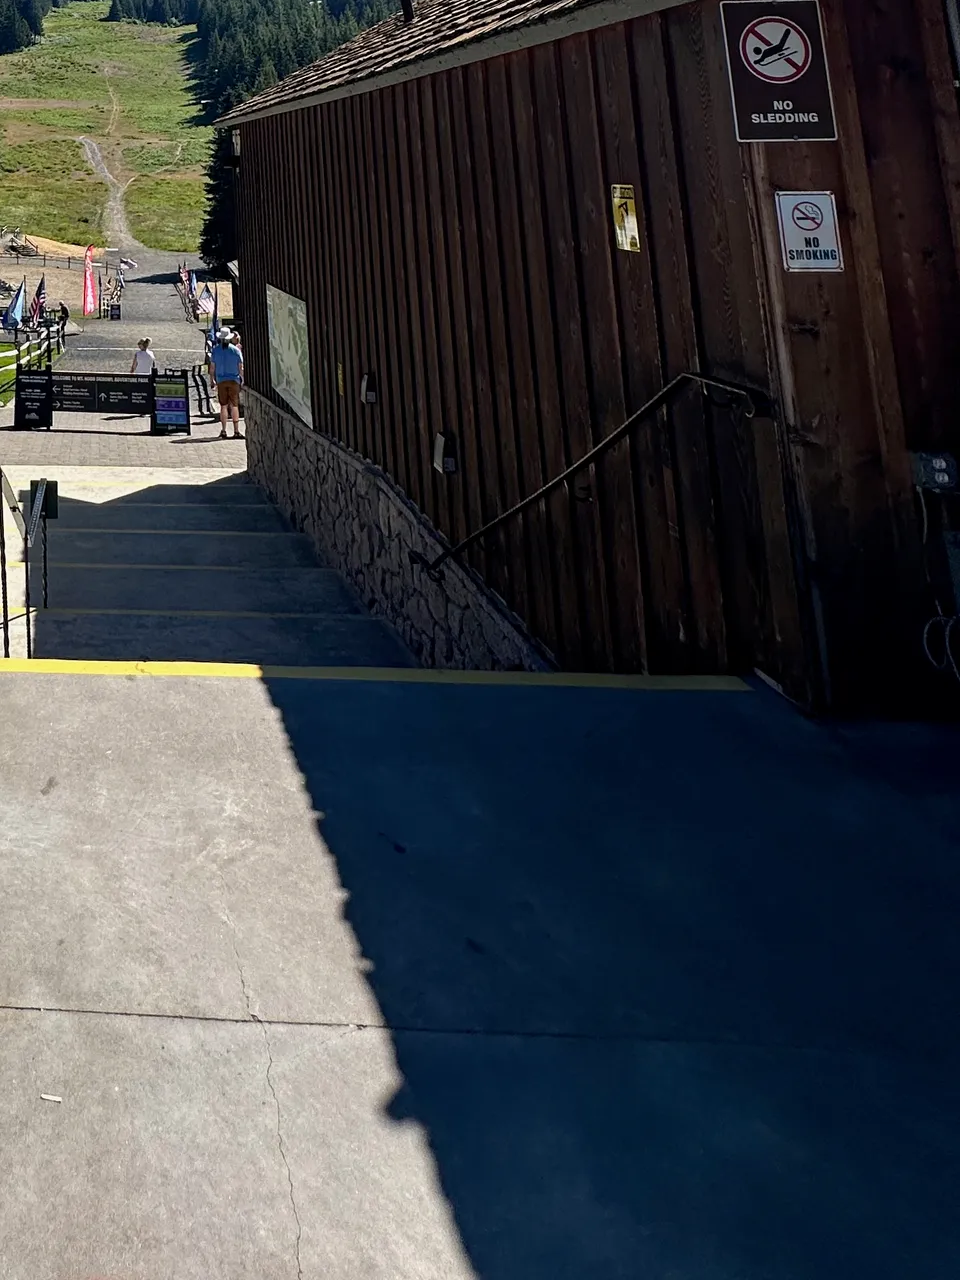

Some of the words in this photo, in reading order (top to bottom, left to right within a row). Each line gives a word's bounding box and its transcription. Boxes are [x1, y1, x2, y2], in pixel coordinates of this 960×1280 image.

[773, 100, 793, 110] NO
[751, 113, 819, 123] SLEDDING
[804, 236, 820, 248] NO
[788, 249, 838, 261] SMOKING
